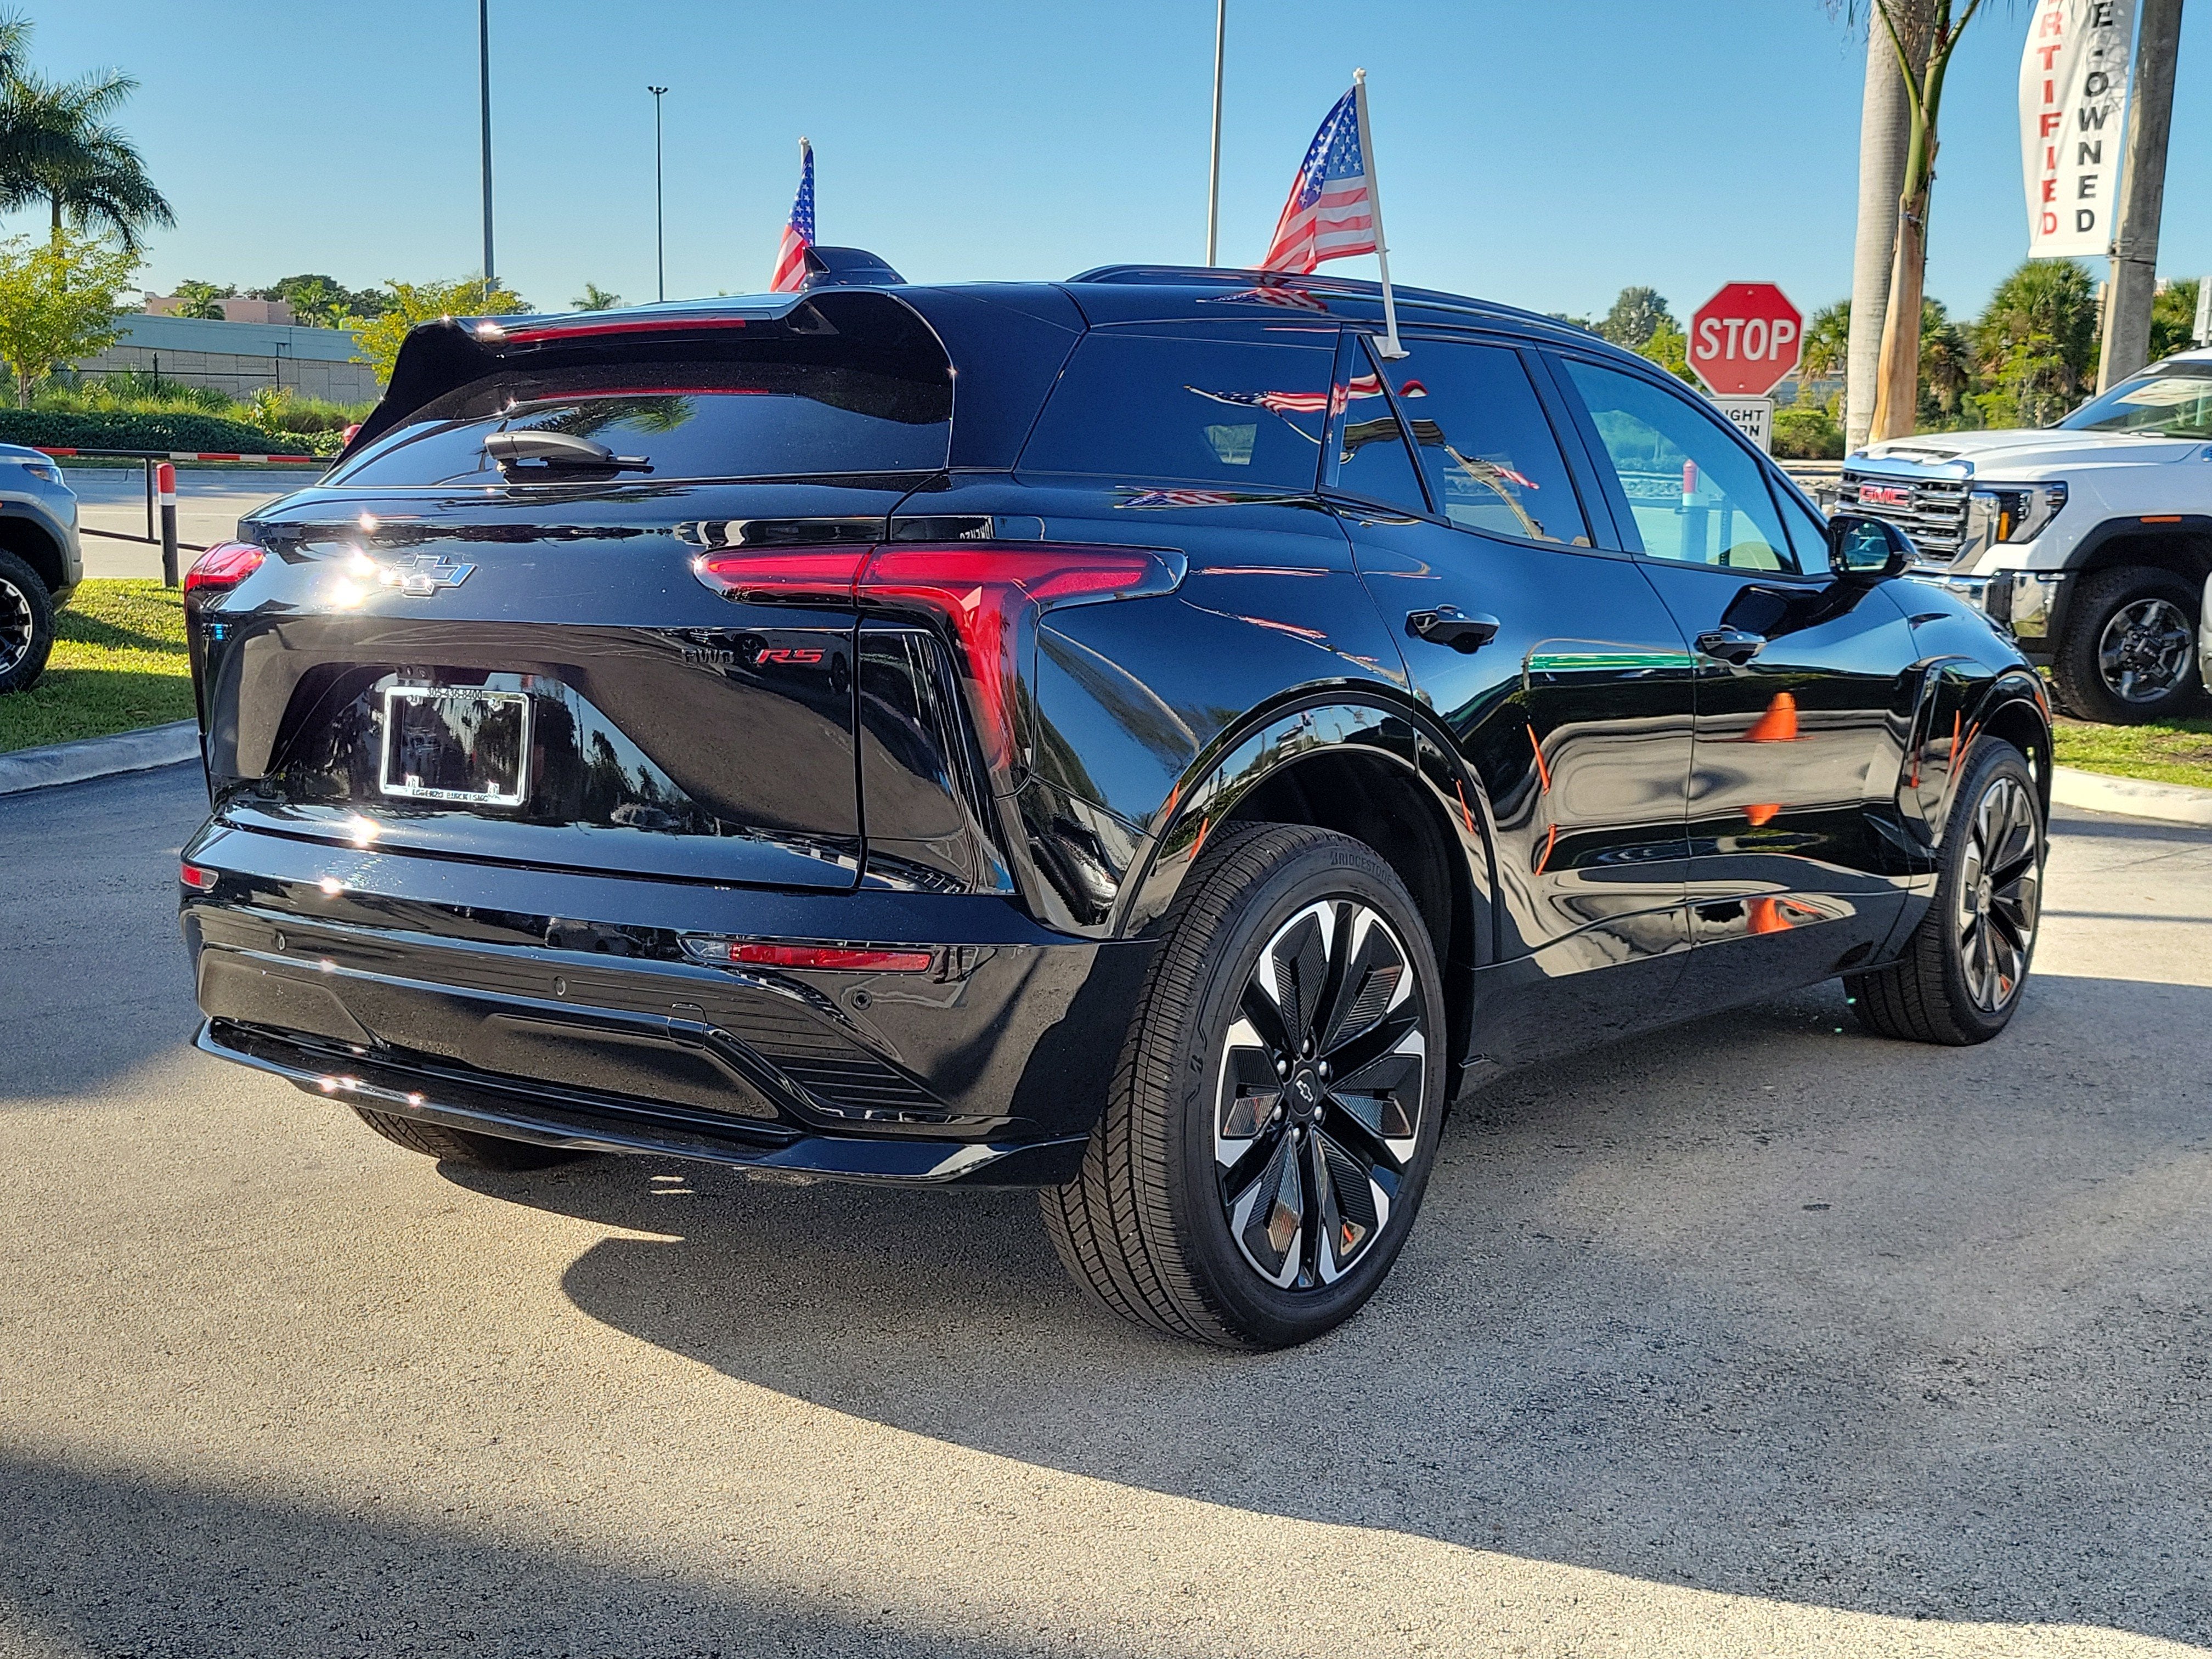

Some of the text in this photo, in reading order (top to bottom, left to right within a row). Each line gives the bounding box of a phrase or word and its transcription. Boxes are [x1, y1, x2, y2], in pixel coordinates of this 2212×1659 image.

[2036, 0, 2063, 235] RTIFIED
[1696, 318, 1797, 360] STOP
[1859, 485, 1910, 506] GMC
[753, 648, 827, 663] RS
[427, 687, 482, 699] 305-436-8400
[1330, 851, 1392, 884] BRIDGESTONE
